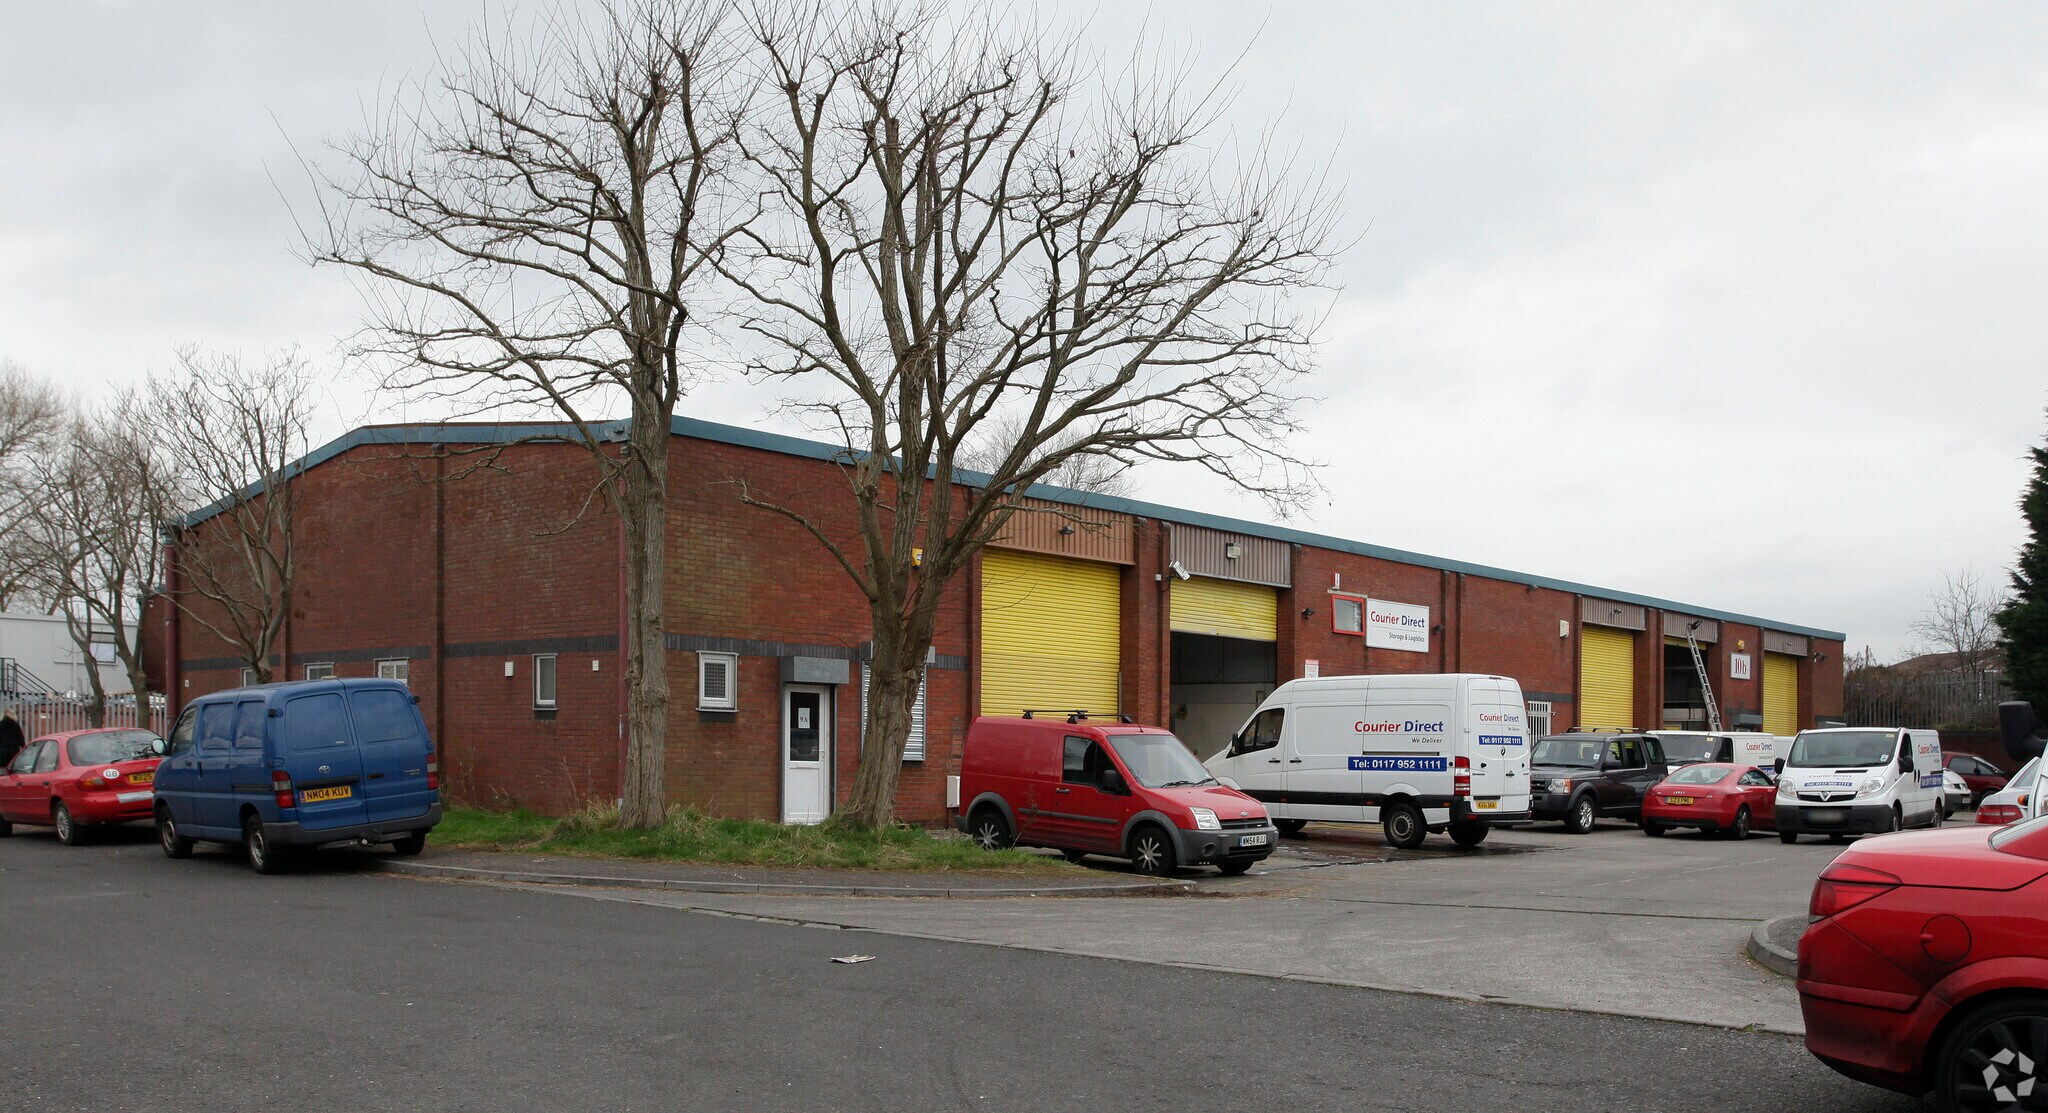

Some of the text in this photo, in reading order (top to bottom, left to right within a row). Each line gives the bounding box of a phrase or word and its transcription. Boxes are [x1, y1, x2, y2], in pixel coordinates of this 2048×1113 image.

[1370, 611, 1425, 628] Courier Direct
[1388, 631, 1404, 641] Storage
[1408, 634, 1425, 643] Logistics
[1735, 657, 1747, 675] 10b
[1479, 713, 1519, 723] Courier Direct
[1354, 720, 1444, 733] Courier Direct
[1745, 742, 1760, 751] Courier
[1353, 759, 1441, 769] Tel: 0117 952 1111
[105, 770, 118, 778] GB
[306, 786, 349, 801] NM04 KUV
